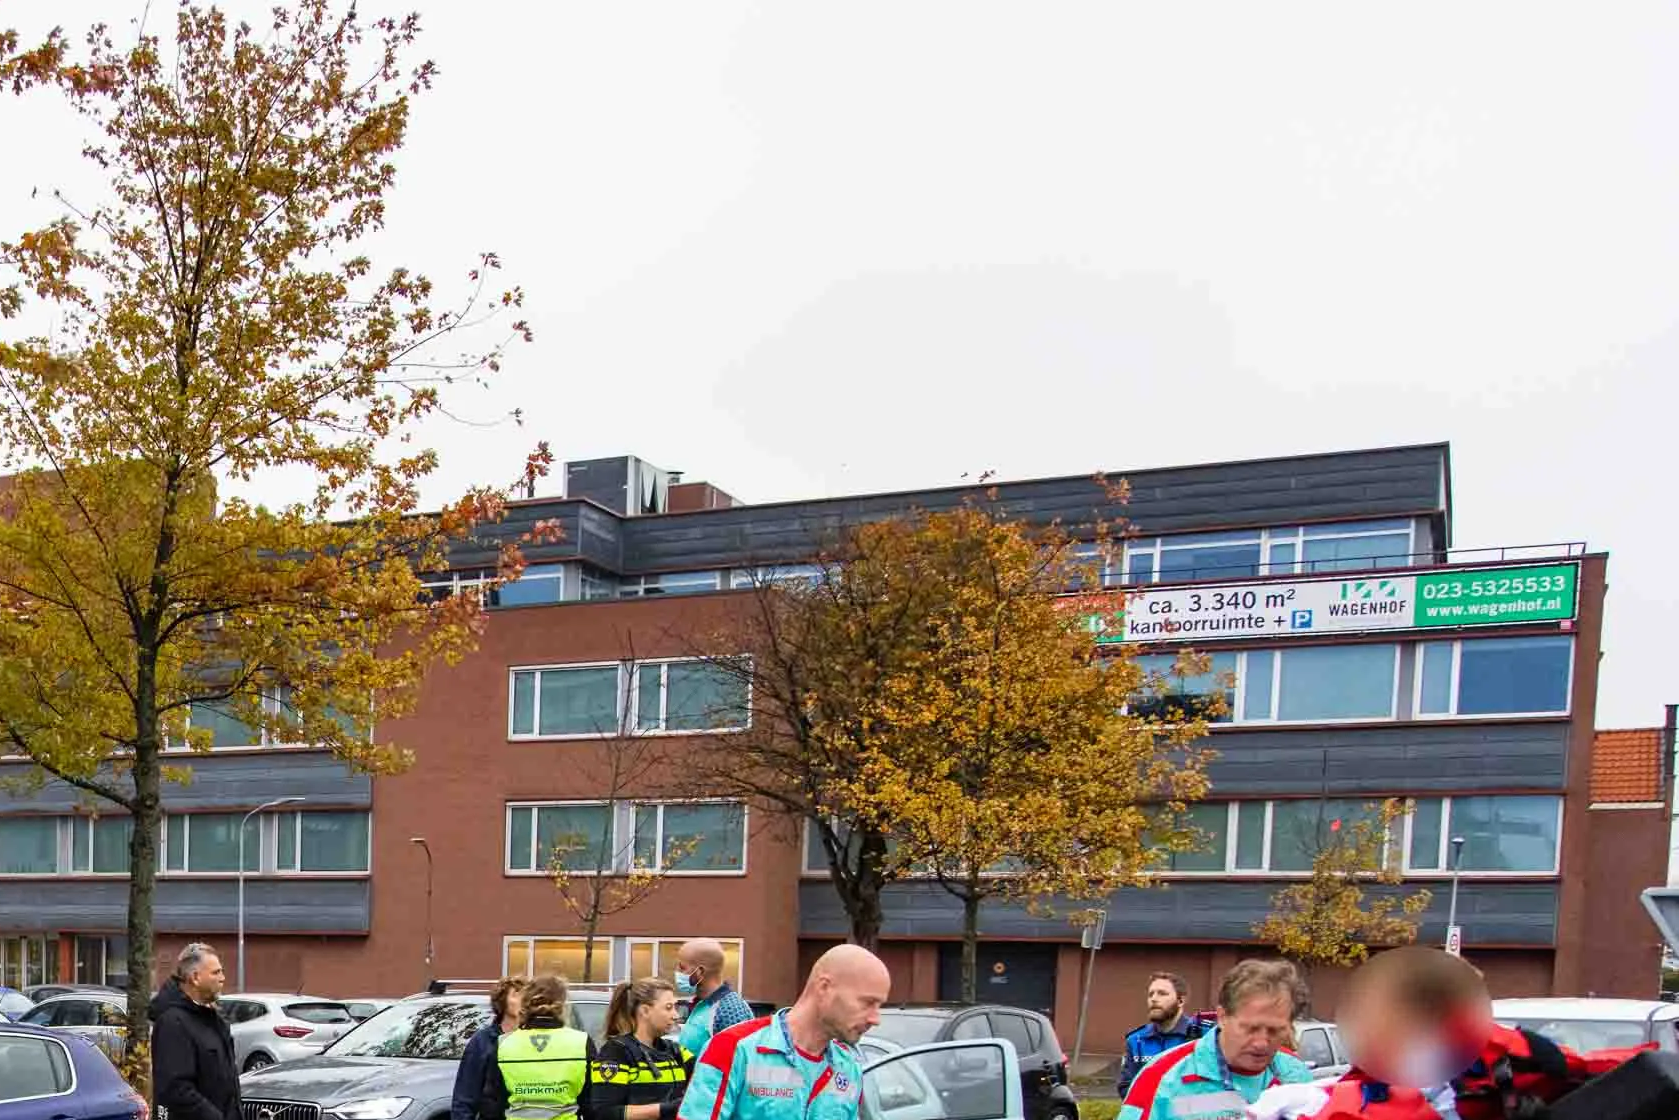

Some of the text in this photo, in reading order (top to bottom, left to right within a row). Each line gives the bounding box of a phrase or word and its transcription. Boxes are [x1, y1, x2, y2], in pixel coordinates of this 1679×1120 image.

[1422, 575, 1566, 599] 023-5325533
[1148, 599, 1179, 614] ca.
[1188, 590, 1256, 612] 3.340
[1328, 600, 1407, 617] WAGENHOF
[1426, 597, 1561, 618] www.wagenhof.nl
[515, 1086, 568, 1095] Brinkman
[749, 1087, 794, 1099] AMBULANCE
